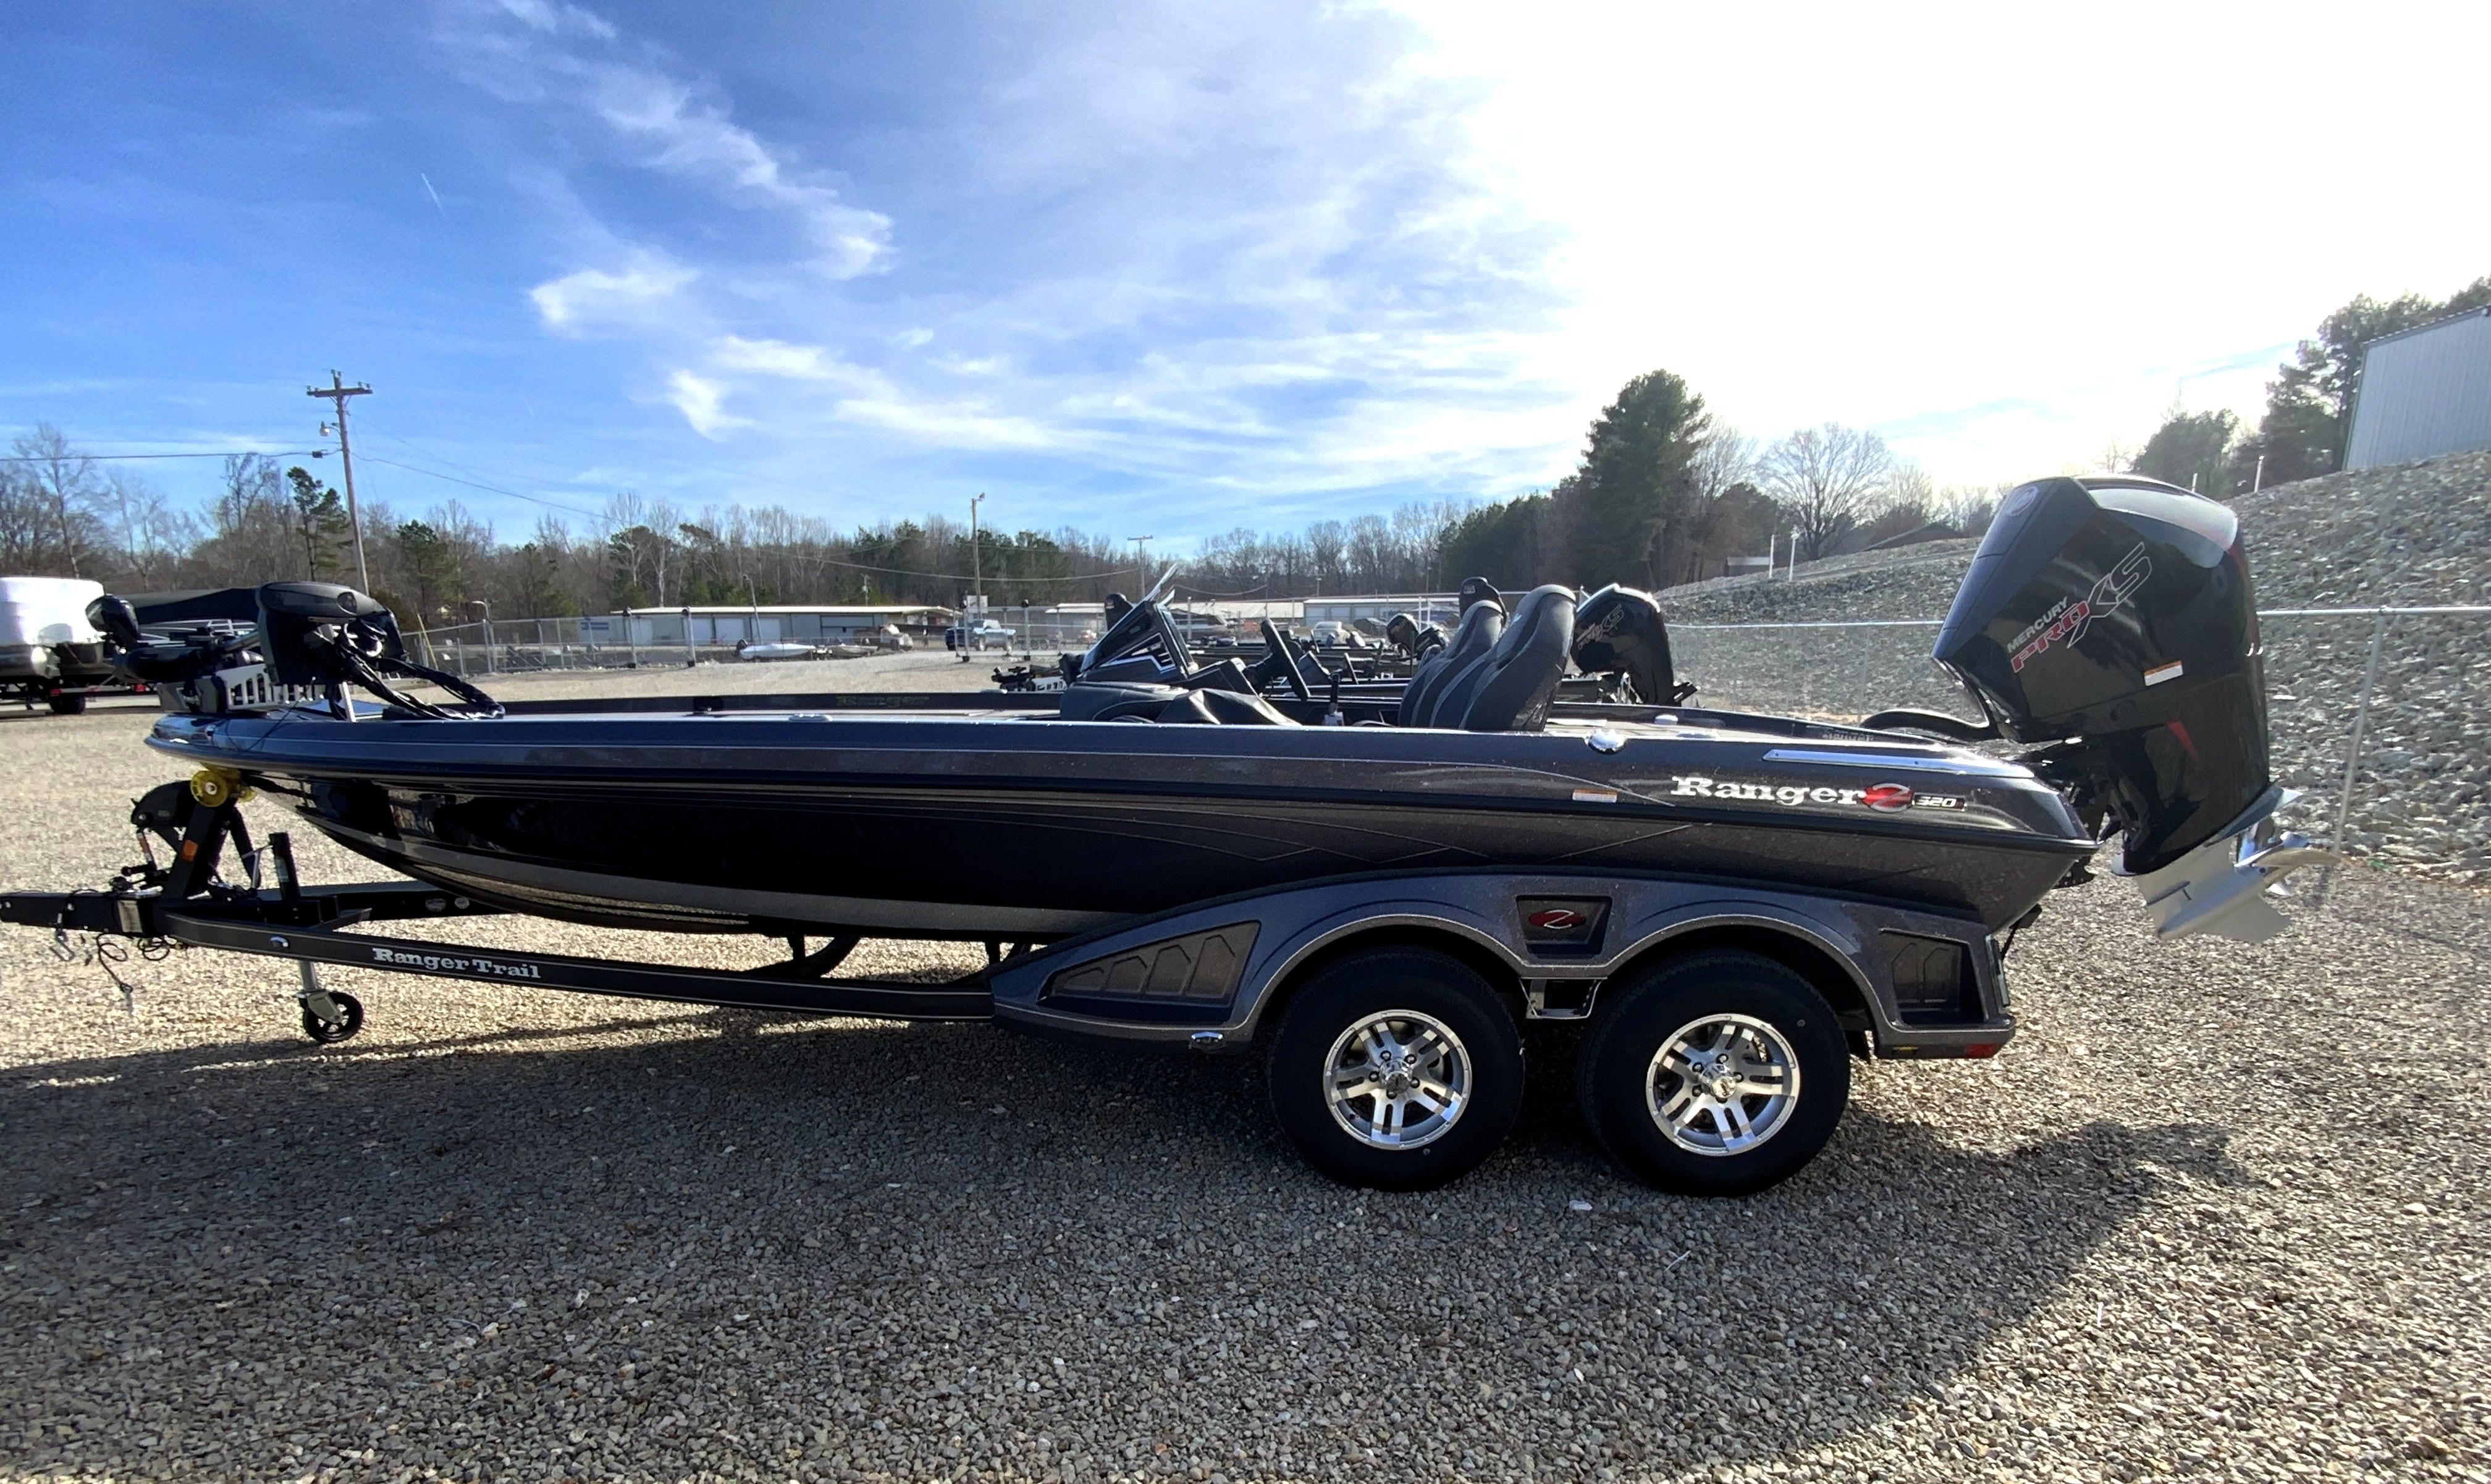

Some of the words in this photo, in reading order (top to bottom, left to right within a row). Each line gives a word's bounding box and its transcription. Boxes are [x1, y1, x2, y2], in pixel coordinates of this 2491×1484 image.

[2007, 596, 2067, 652] MERCURY
[2011, 600, 2090, 673] PRO
[2065, 541, 2152, 649] XS
[1671, 776, 1867, 806] Ranger
[373, 948, 470, 970] Ranger
[472, 959, 541, 979] Trail
